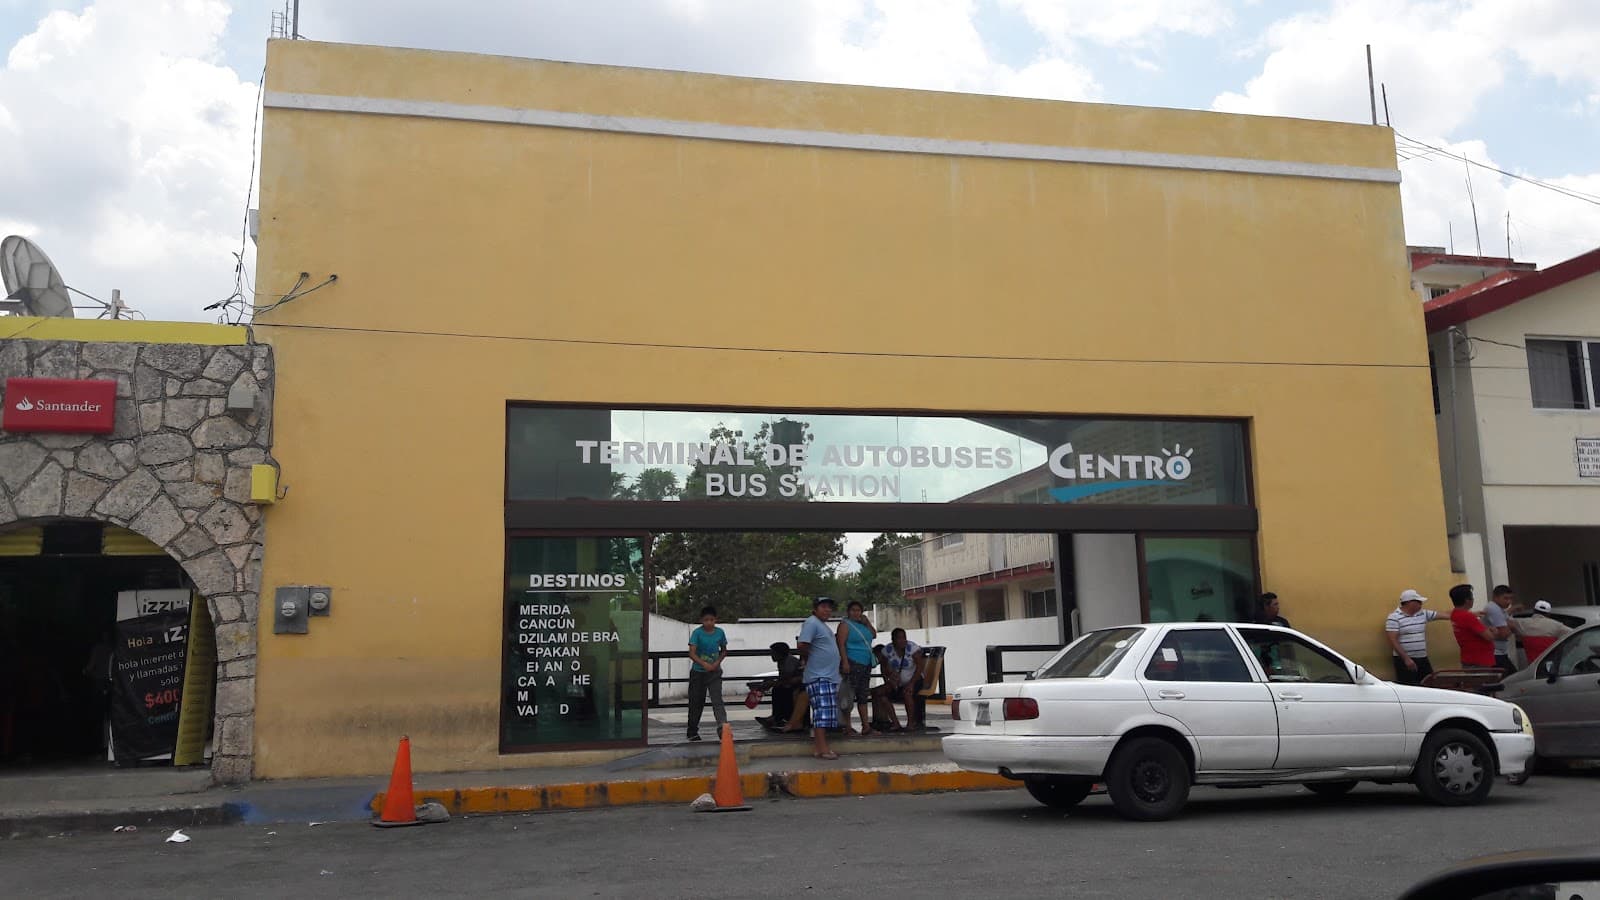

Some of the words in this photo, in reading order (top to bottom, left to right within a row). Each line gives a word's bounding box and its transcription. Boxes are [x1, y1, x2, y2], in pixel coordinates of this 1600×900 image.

[36, 400, 101, 412] Santander
[575, 440, 756, 467] TERMINAL
[765, 444, 808, 467] DE
[821, 445, 1014, 470] AUTOBUSES
[706, 473, 767, 497] BUS
[778, 474, 899, 498] STATION
[529, 574, 626, 588] DESTINOS
[519, 604, 571, 616] MERIDA
[519, 616, 575, 630] CANCÚN
[127, 636, 153, 649] Hola
[519, 633, 568, 644] DZILAM
[571, 632, 589, 643] DE
[593, 632, 620, 642] BRA
[118, 660, 139, 671] hola
[136, 664, 179, 679] llamadas
[160, 676, 180, 687] solo
